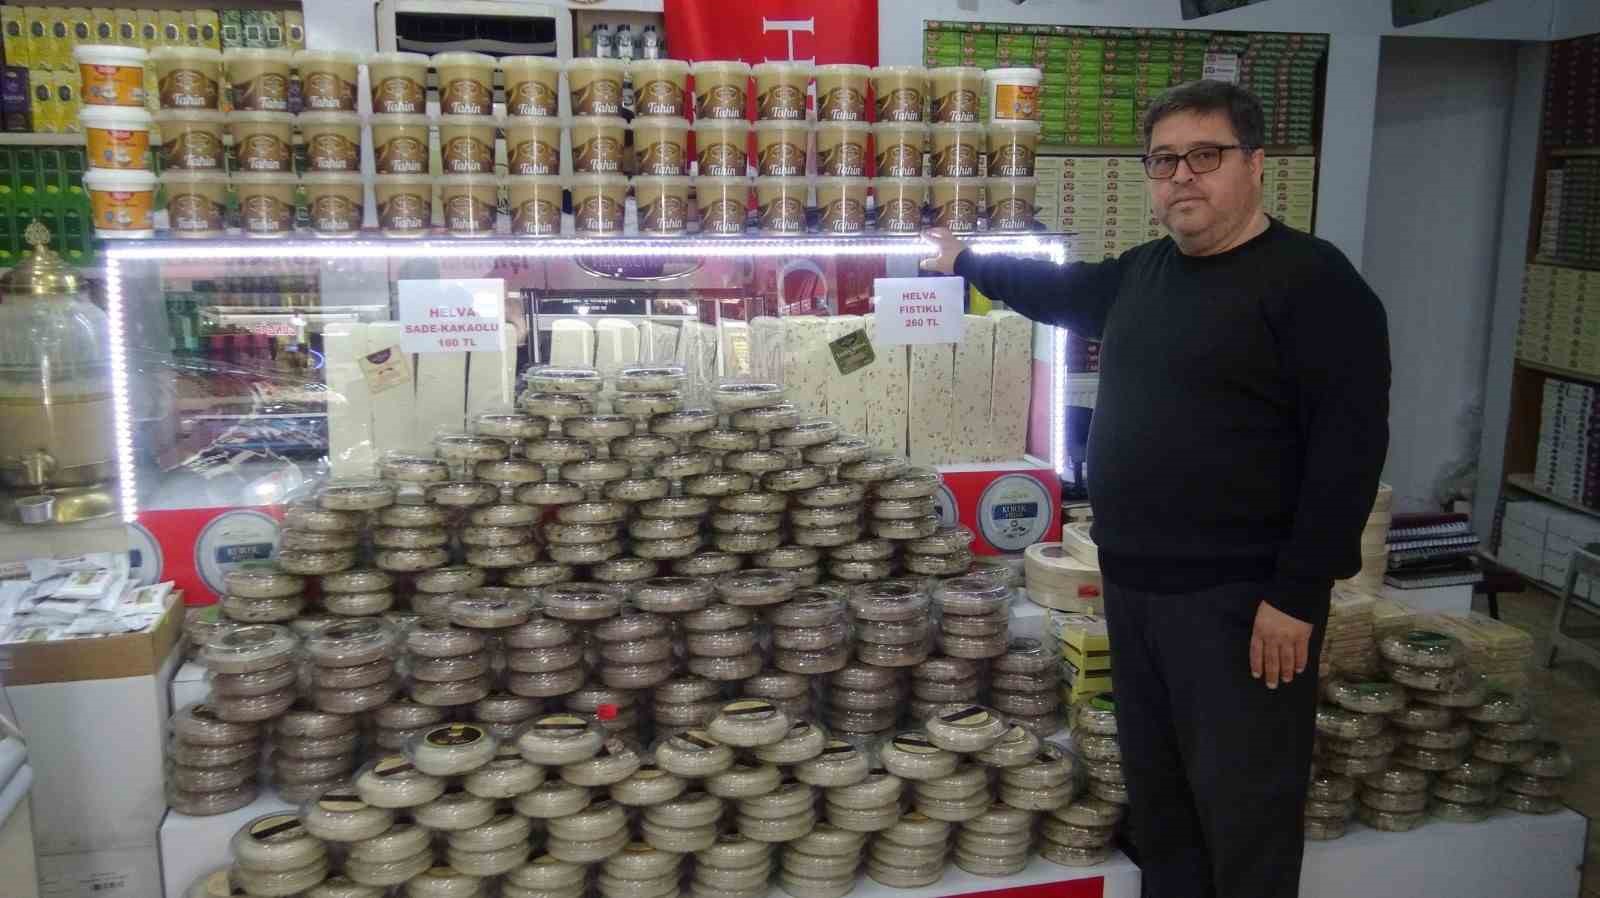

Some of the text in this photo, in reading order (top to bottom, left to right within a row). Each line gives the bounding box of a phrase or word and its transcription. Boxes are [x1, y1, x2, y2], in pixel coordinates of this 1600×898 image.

[384, 101, 415, 113] Tahin
[451, 101, 480, 114] Tahin
[519, 103, 547, 117] Tahin
[592, 102, 618, 114] Tahin
[647, 102, 675, 114] Tahin
[713, 106, 739, 118] Tahin
[771, 106, 799, 118] Tahin
[831, 109, 857, 121] Tahin
[892, 109, 918, 121] Tahin
[950, 109, 975, 121] Tahin
[391, 159, 421, 171] Tahin
[451, 159, 480, 172] Tahin
[520, 162, 548, 175] Tahin
[590, 158, 617, 171] Tahin
[653, 163, 679, 175] Tahin
[709, 164, 736, 177] Tahin
[769, 163, 796, 175] Tahin
[836, 164, 861, 176] Tahin
[889, 164, 915, 176] Tahin
[947, 164, 973, 176] Tahin
[1000, 164, 1026, 176] Tahin
[392, 216, 422, 228] Tahin
[450, 217, 479, 229] Tahin
[525, 221, 552, 233] Tahin
[585, 217, 614, 230] Tahin
[656, 216, 682, 229] Tahin
[713, 219, 740, 232] Tahin
[771, 217, 800, 230] Tahin
[832, 218, 858, 231] Tahin
[889, 217, 914, 231] Tahin
[947, 218, 972, 231] Tahin
[1000, 216, 1025, 230] Tahin
[902, 292, 937, 301] HELVA
[429, 308, 476, 318] HELVA
[405, 323, 499, 334] SADE-KAKAOLU
[927, 318, 940, 327] TL
[464, 338, 477, 347] TL
